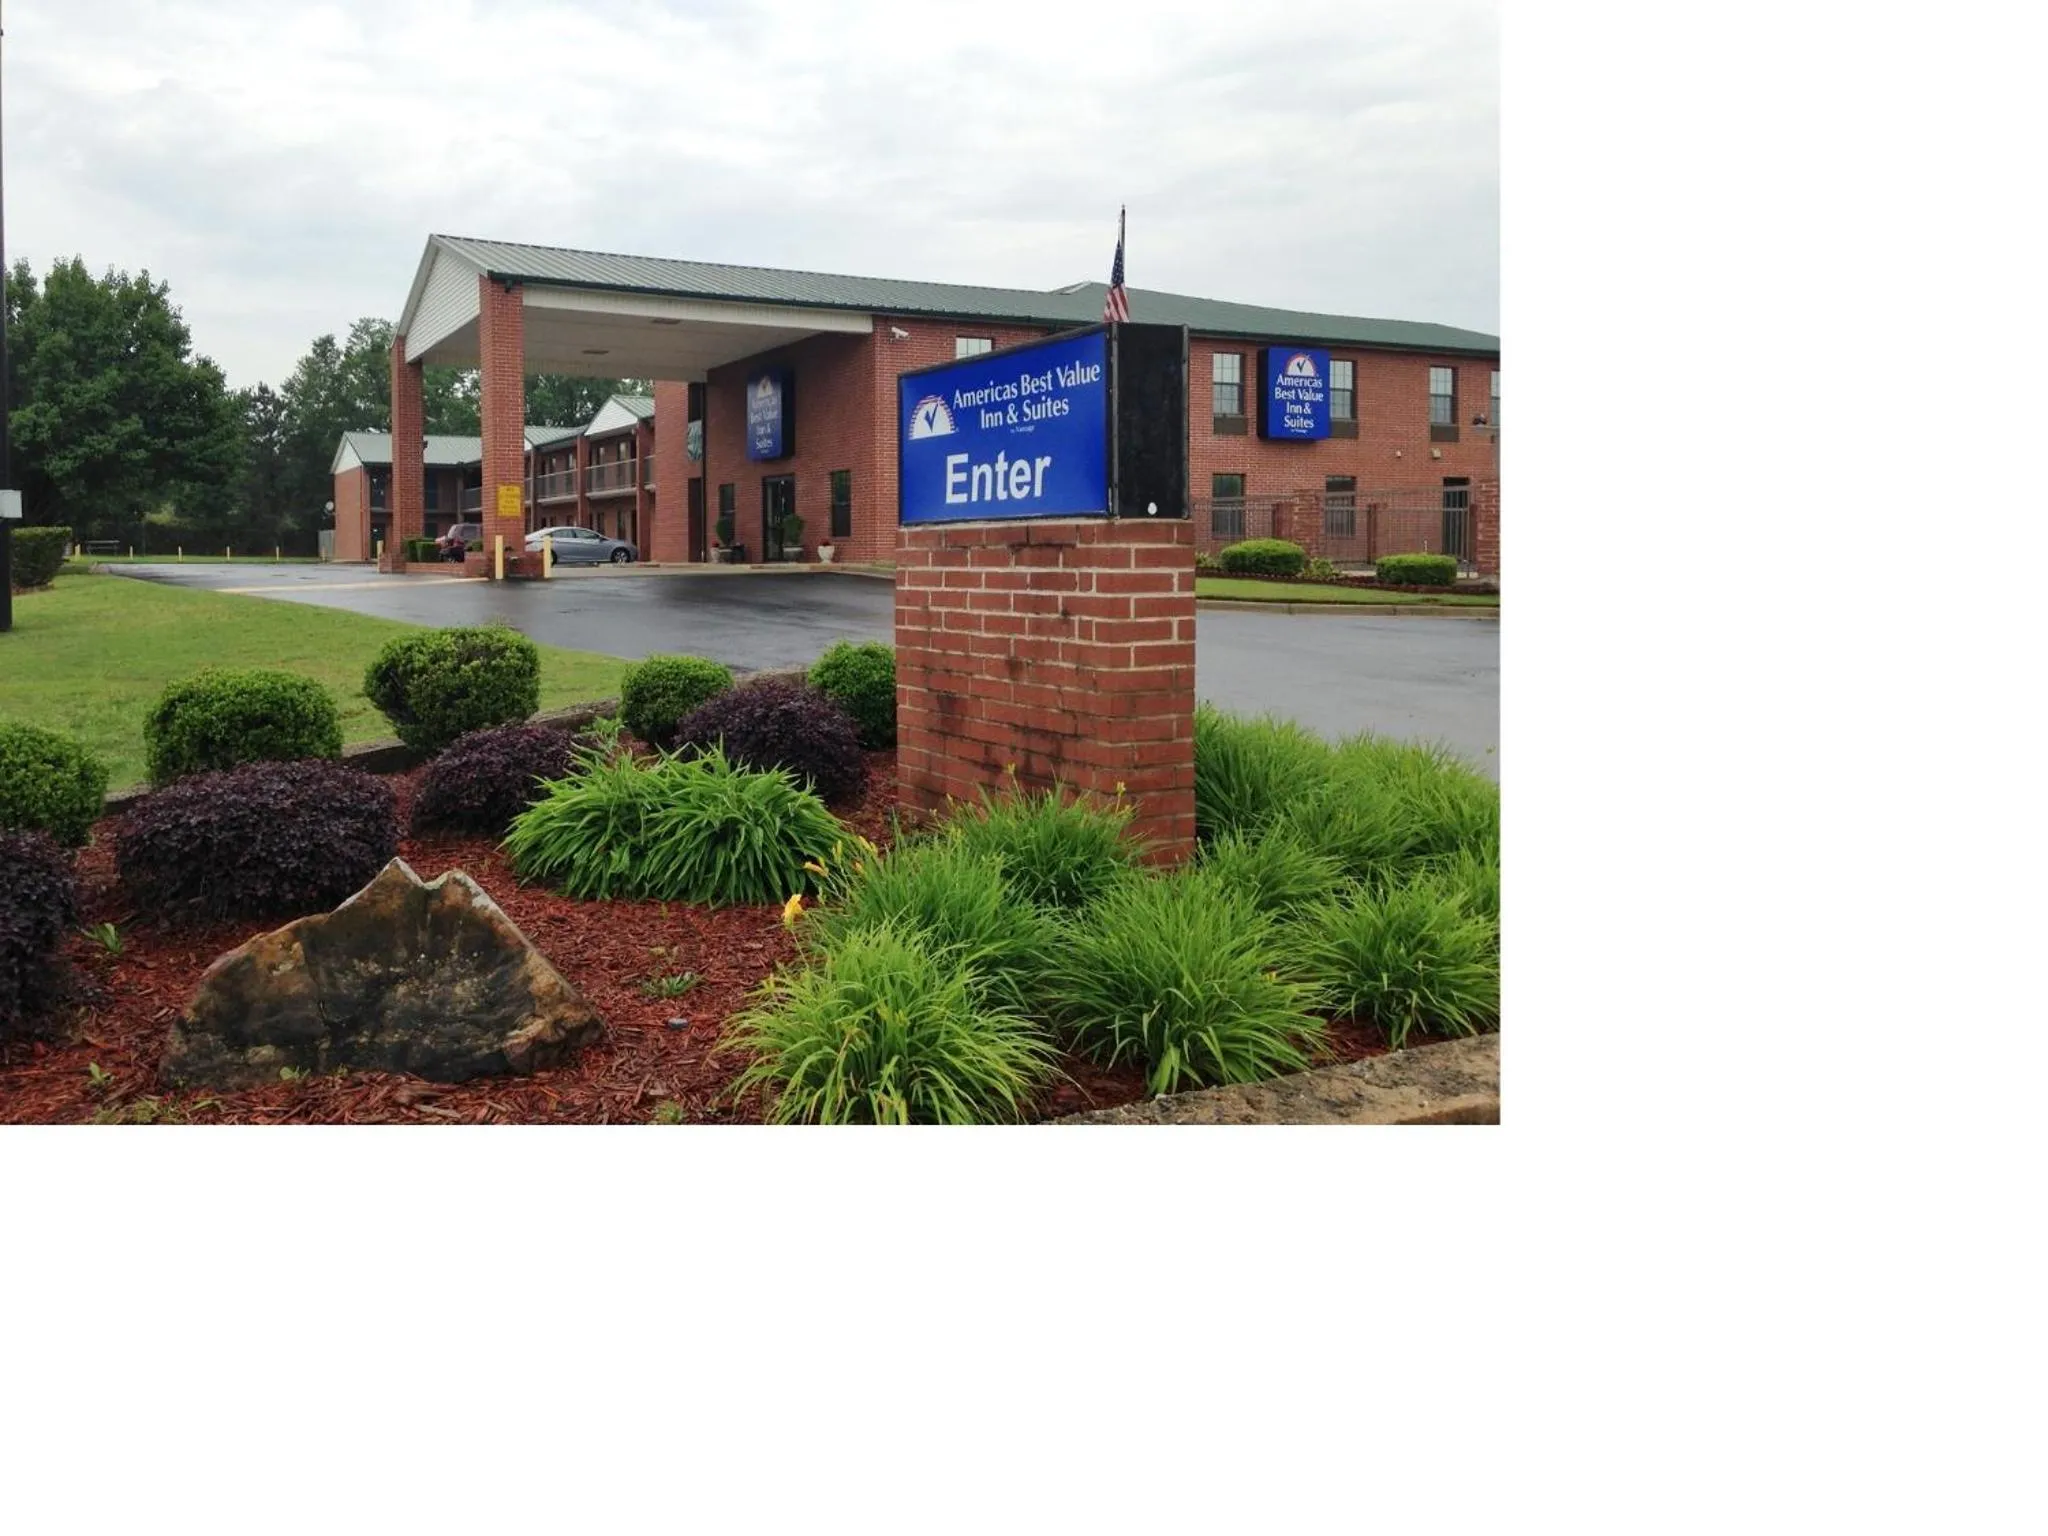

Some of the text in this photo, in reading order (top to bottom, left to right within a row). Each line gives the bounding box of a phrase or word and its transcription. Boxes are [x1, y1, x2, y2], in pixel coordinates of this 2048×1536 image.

[952, 360, 1101, 410] Americas Best Value
[1276, 373, 1323, 388] Americas
[1274, 387, 1324, 402] Best Value
[980, 396, 1070, 429] Inn & Suites
[1286, 401, 1312, 415] Inn &
[1284, 414, 1315, 429] Suites
[945, 450, 1052, 504] Enter
